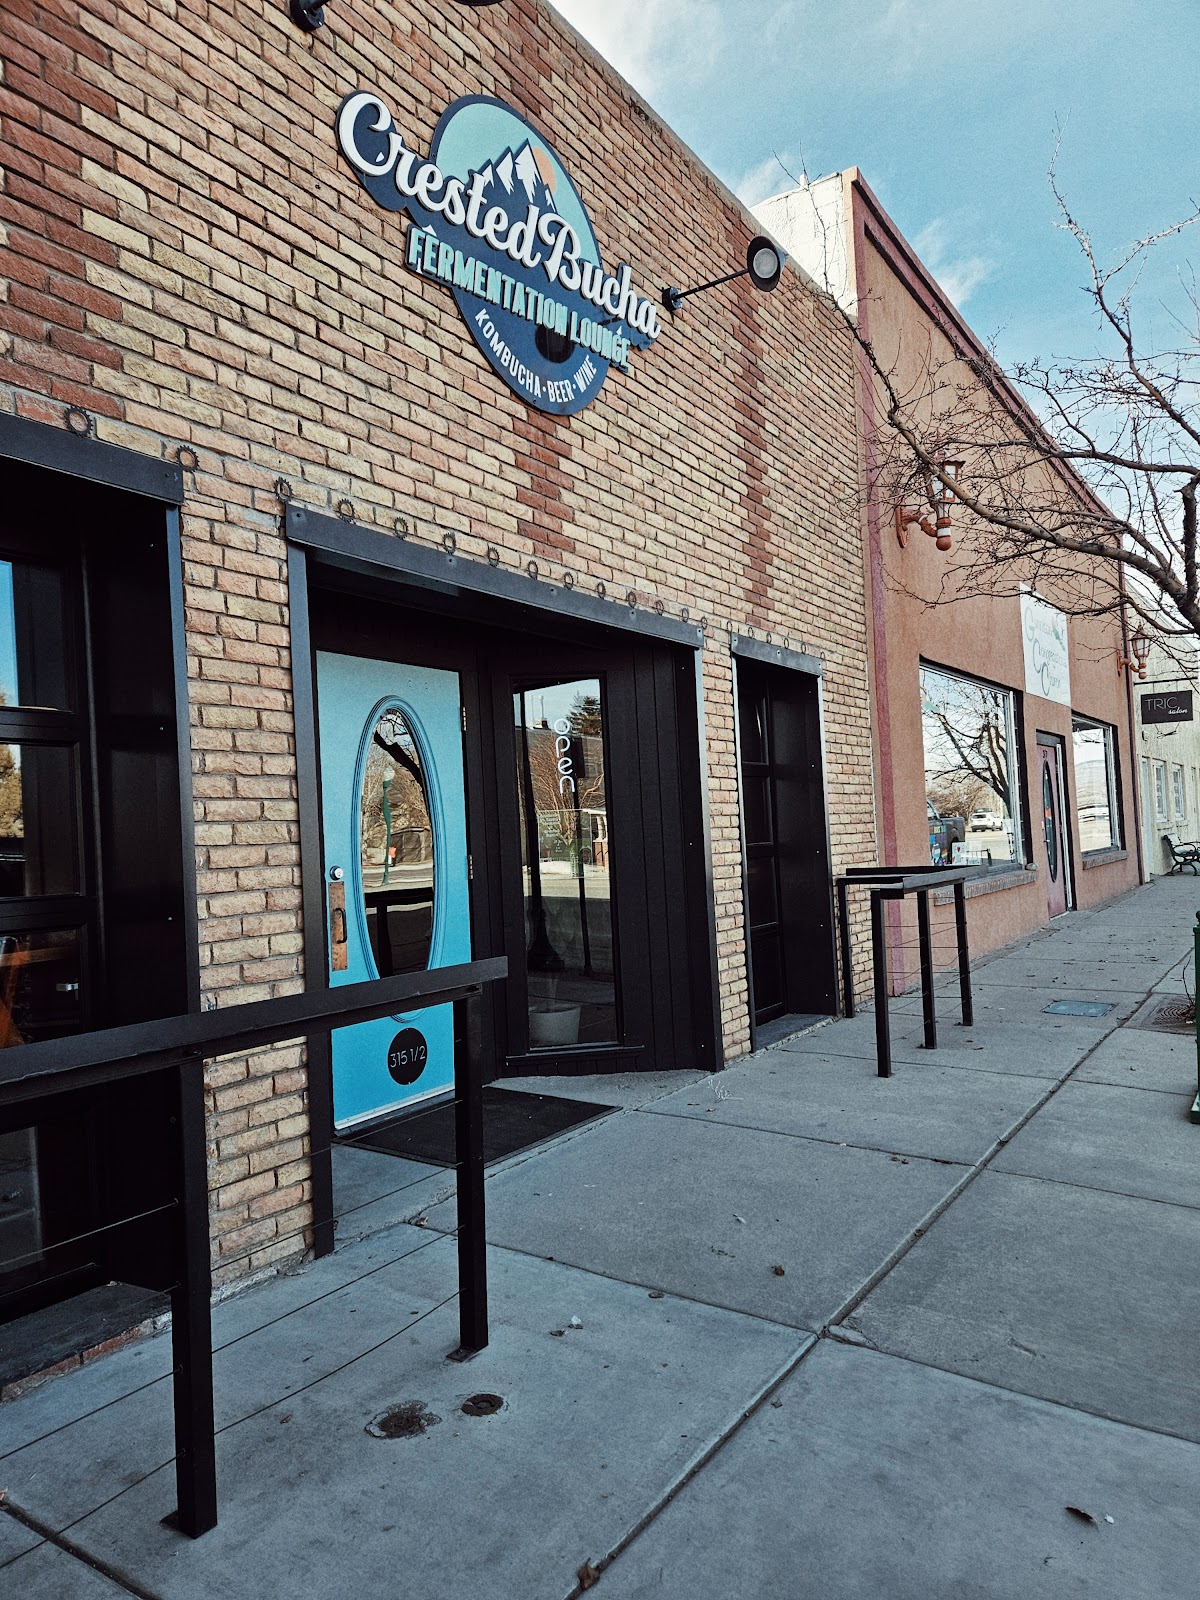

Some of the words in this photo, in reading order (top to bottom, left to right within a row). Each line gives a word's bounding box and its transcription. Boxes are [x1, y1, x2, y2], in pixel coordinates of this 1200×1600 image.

[338, 92, 542, 268] Crested
[538, 212, 661, 340] Bucha
[474, 308, 543, 399] KOMBUCHA
[547, 379, 576, 403] BEER
[575, 354, 599, 394] WINE
[571, 318, 632, 369] LOUNGE
[1144, 696, 1178, 711] TRIC
[1168, 706, 1189, 715] salon
[389, 1050, 408, 1068] 315
[409, 1045, 426, 1063] 1/2
